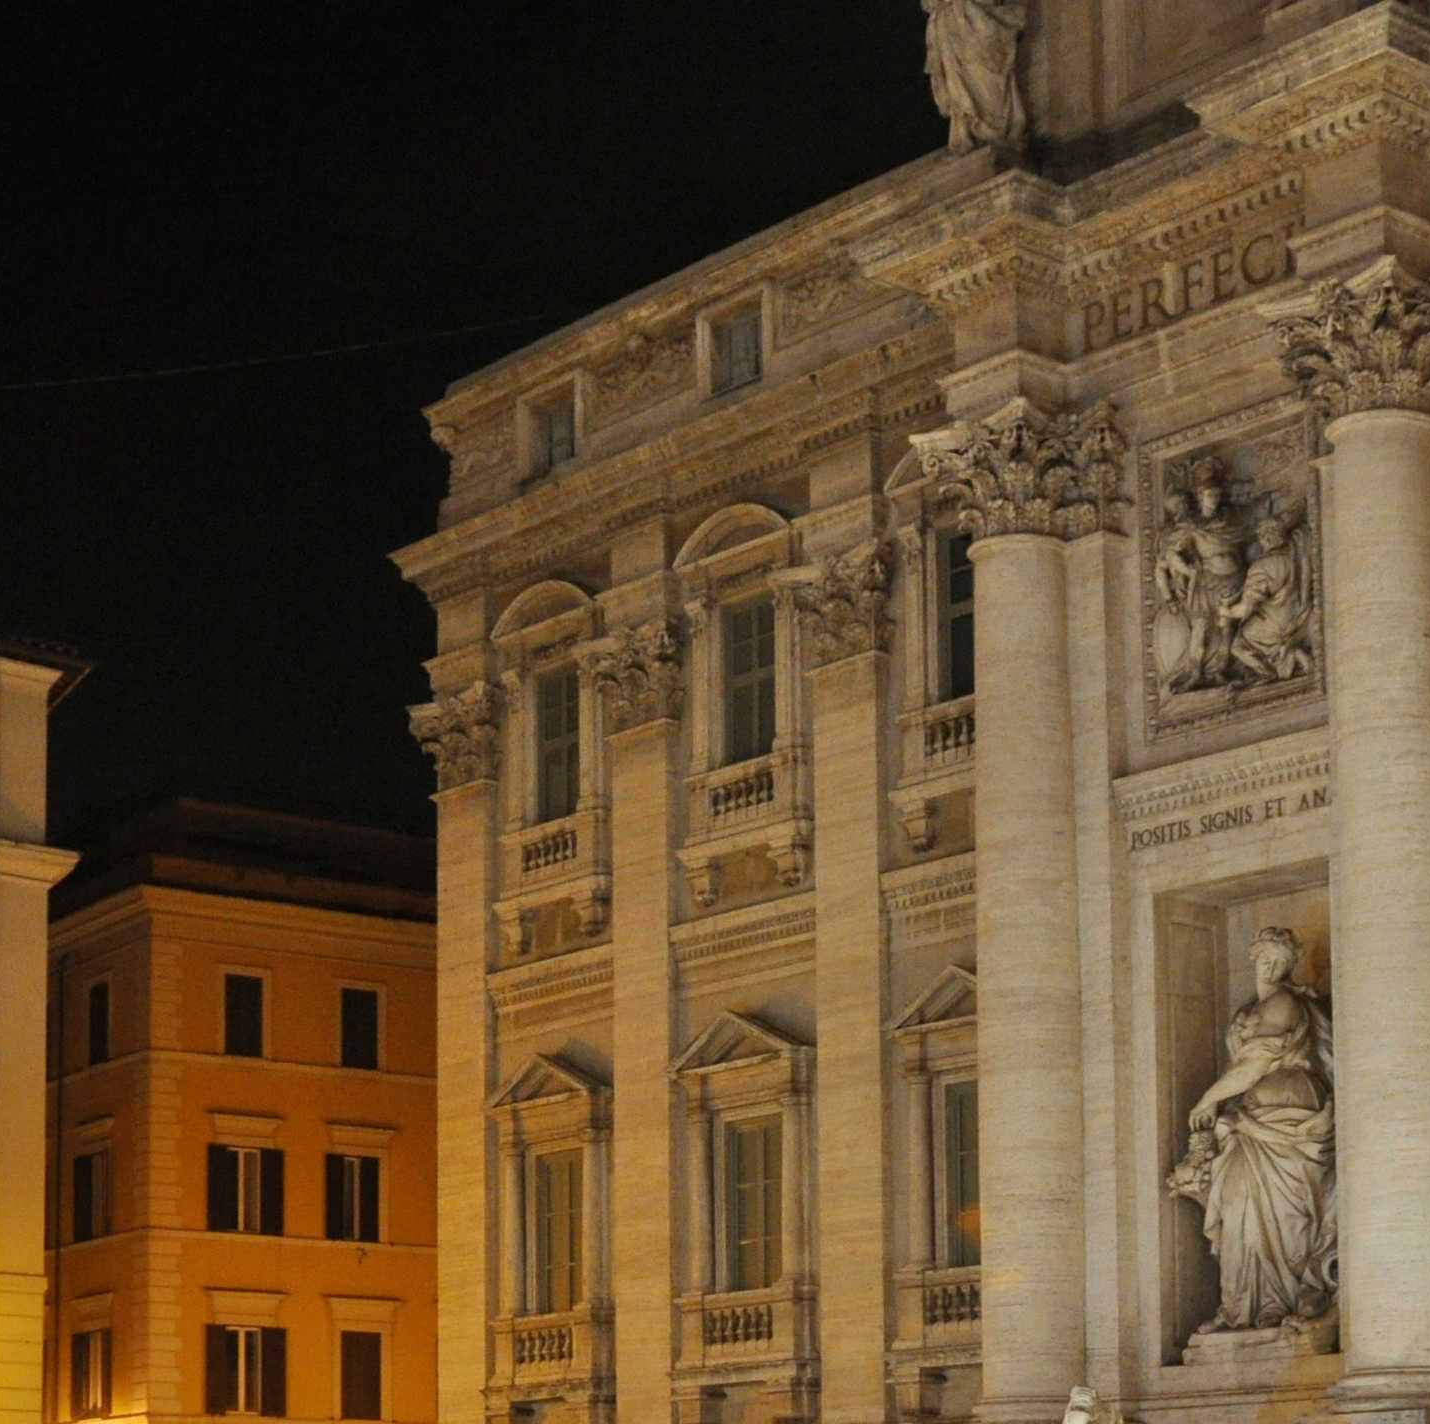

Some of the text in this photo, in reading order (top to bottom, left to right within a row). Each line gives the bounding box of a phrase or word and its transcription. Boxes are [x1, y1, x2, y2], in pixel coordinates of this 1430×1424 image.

[1079, 215, 1306, 353] PERFECI
[1130, 818, 1192, 851] POSITIS
[1199, 803, 1254, 834] SIGNIS
[1265, 796, 1287, 820] ET
